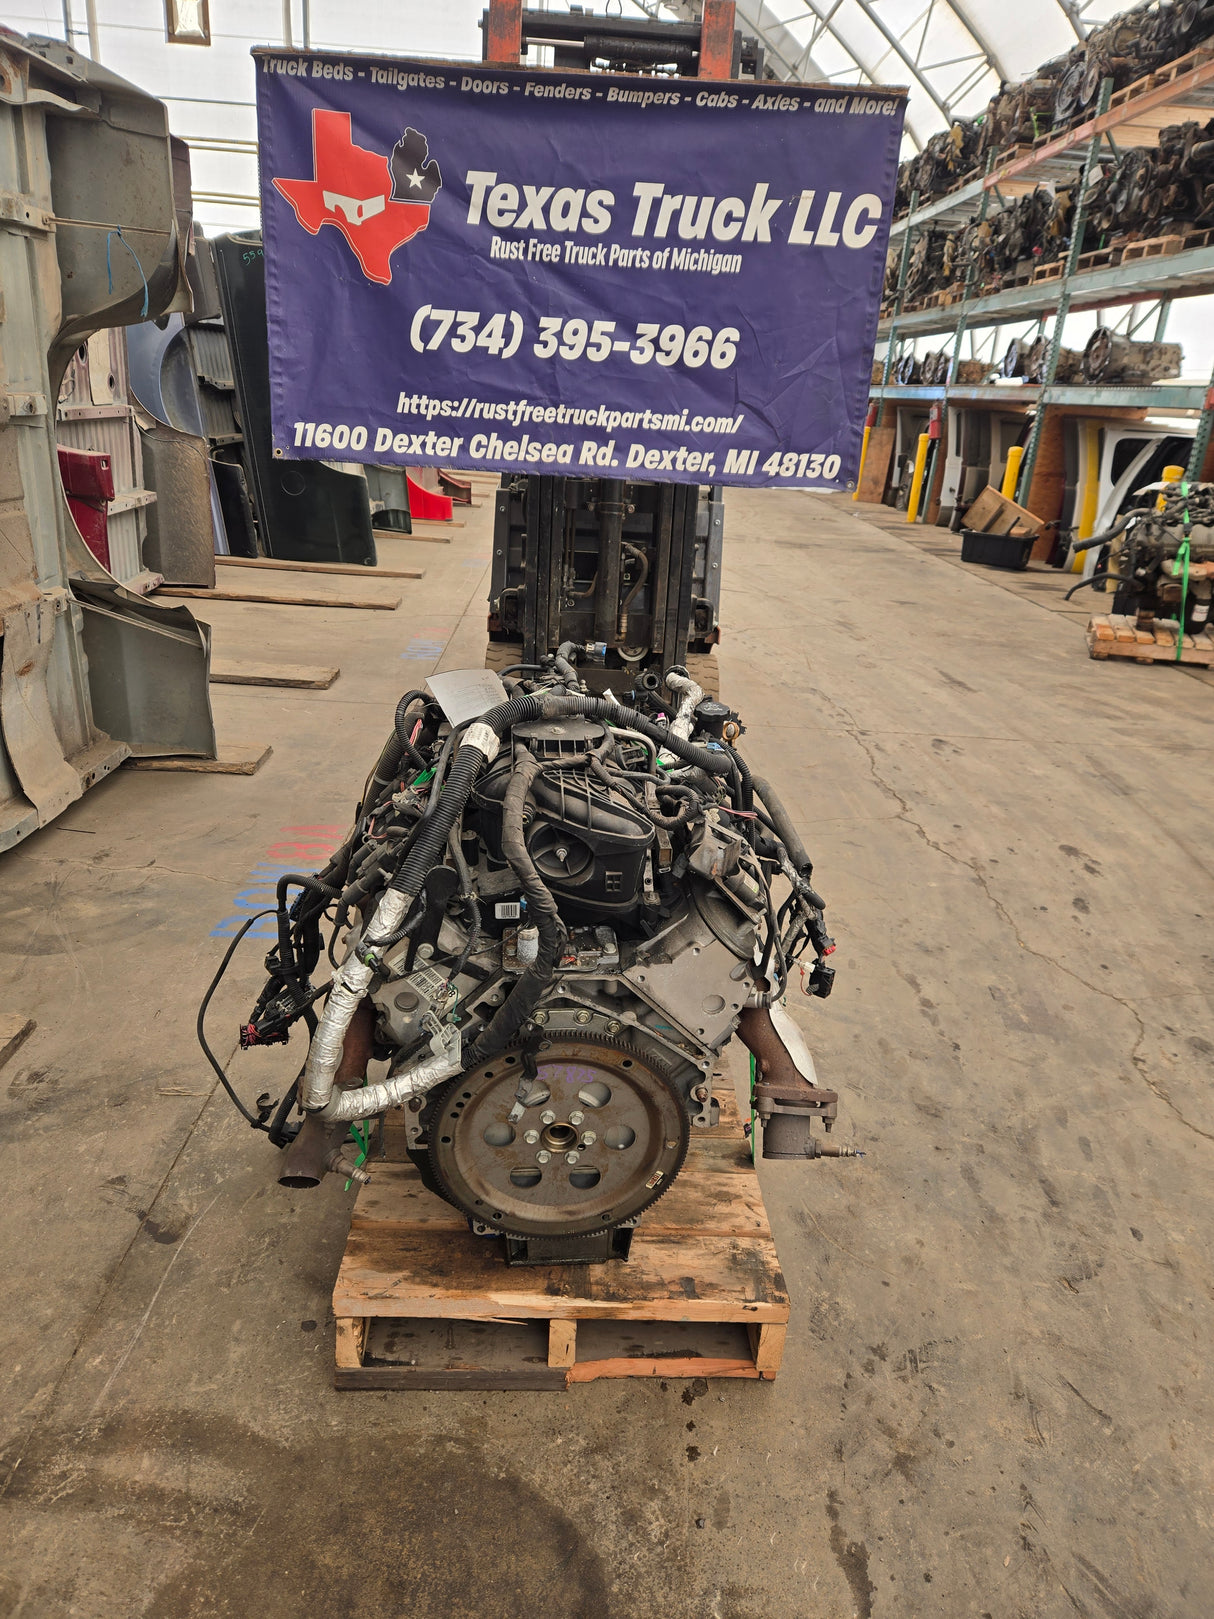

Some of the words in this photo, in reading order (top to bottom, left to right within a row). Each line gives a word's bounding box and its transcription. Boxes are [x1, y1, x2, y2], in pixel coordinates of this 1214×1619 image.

[261, 54, 308, 78] Truck
[312, 62, 353, 80] Beds
[370, 66, 445, 90] Tailgates
[461, 77, 508, 94] Doors
[525, 83, 591, 99] Fenders
[607, 88, 680, 108] Bumpers
[696, 92, 738, 107] Cabs
[751, 95, 800, 111] Axles
[815, 98, 847, 113] and
[849, 99, 897, 116] More!
[466, 170, 615, 235] Texas
[632, 182, 783, 242] Truck
[788, 190, 882, 248] LLC
[490, 236, 525, 260] Rust
[528, 239, 561, 262] Free
[565, 241, 607, 265] Truck
[609, 244, 650, 268] Parts
[652, 248, 670, 269] of
[671, 248, 742, 274] Michigan
[411, 304, 523, 358] (734)
[534, 317, 740, 369] 395-3966
[397, 392, 744, 434] https://rustfreetruckpartsmi.com/
[294, 422, 367, 450] 11600
[374, 428, 463, 457] Dexter
[470, 433, 574, 464] Chelsea
[579, 440, 618, 467] Rd.
[626, 444, 716, 477] Dexter,
[723, 449, 759, 474] MI
[762, 452, 842, 480] 48130
